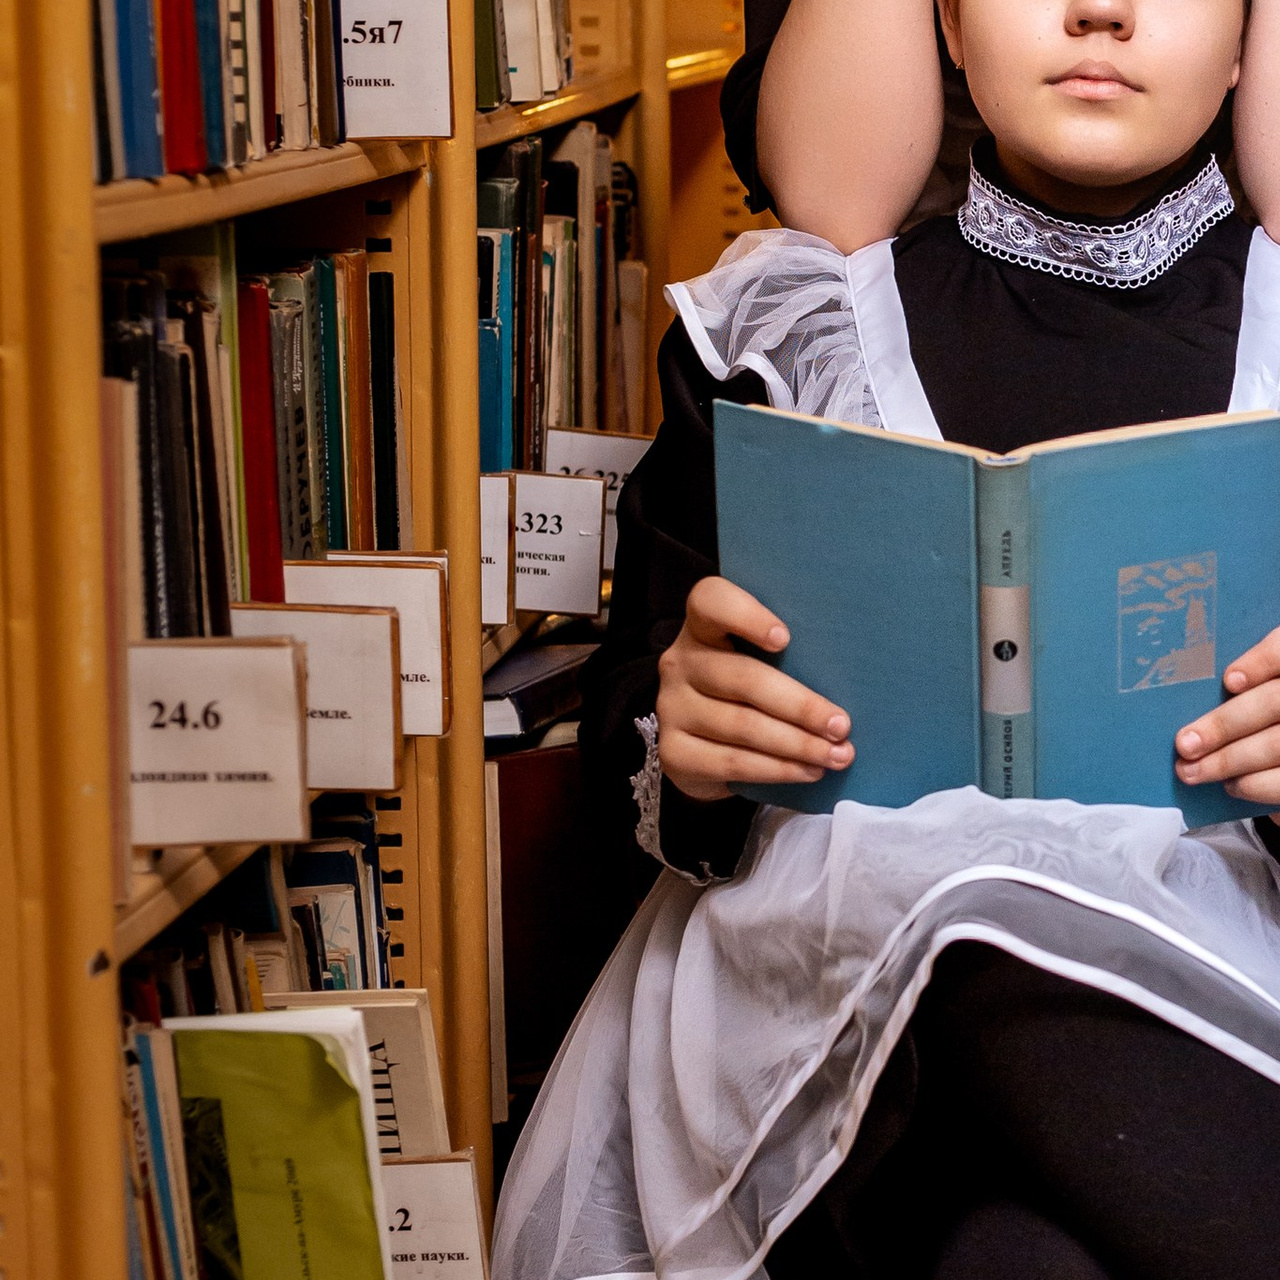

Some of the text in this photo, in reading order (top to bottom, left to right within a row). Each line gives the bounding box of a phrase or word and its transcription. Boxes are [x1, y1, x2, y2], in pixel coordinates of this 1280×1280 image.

[515, 551, 566, 563] ическая
[149, 699, 221, 730] 24.6
[421, 1252, 470, 1267] науки.
